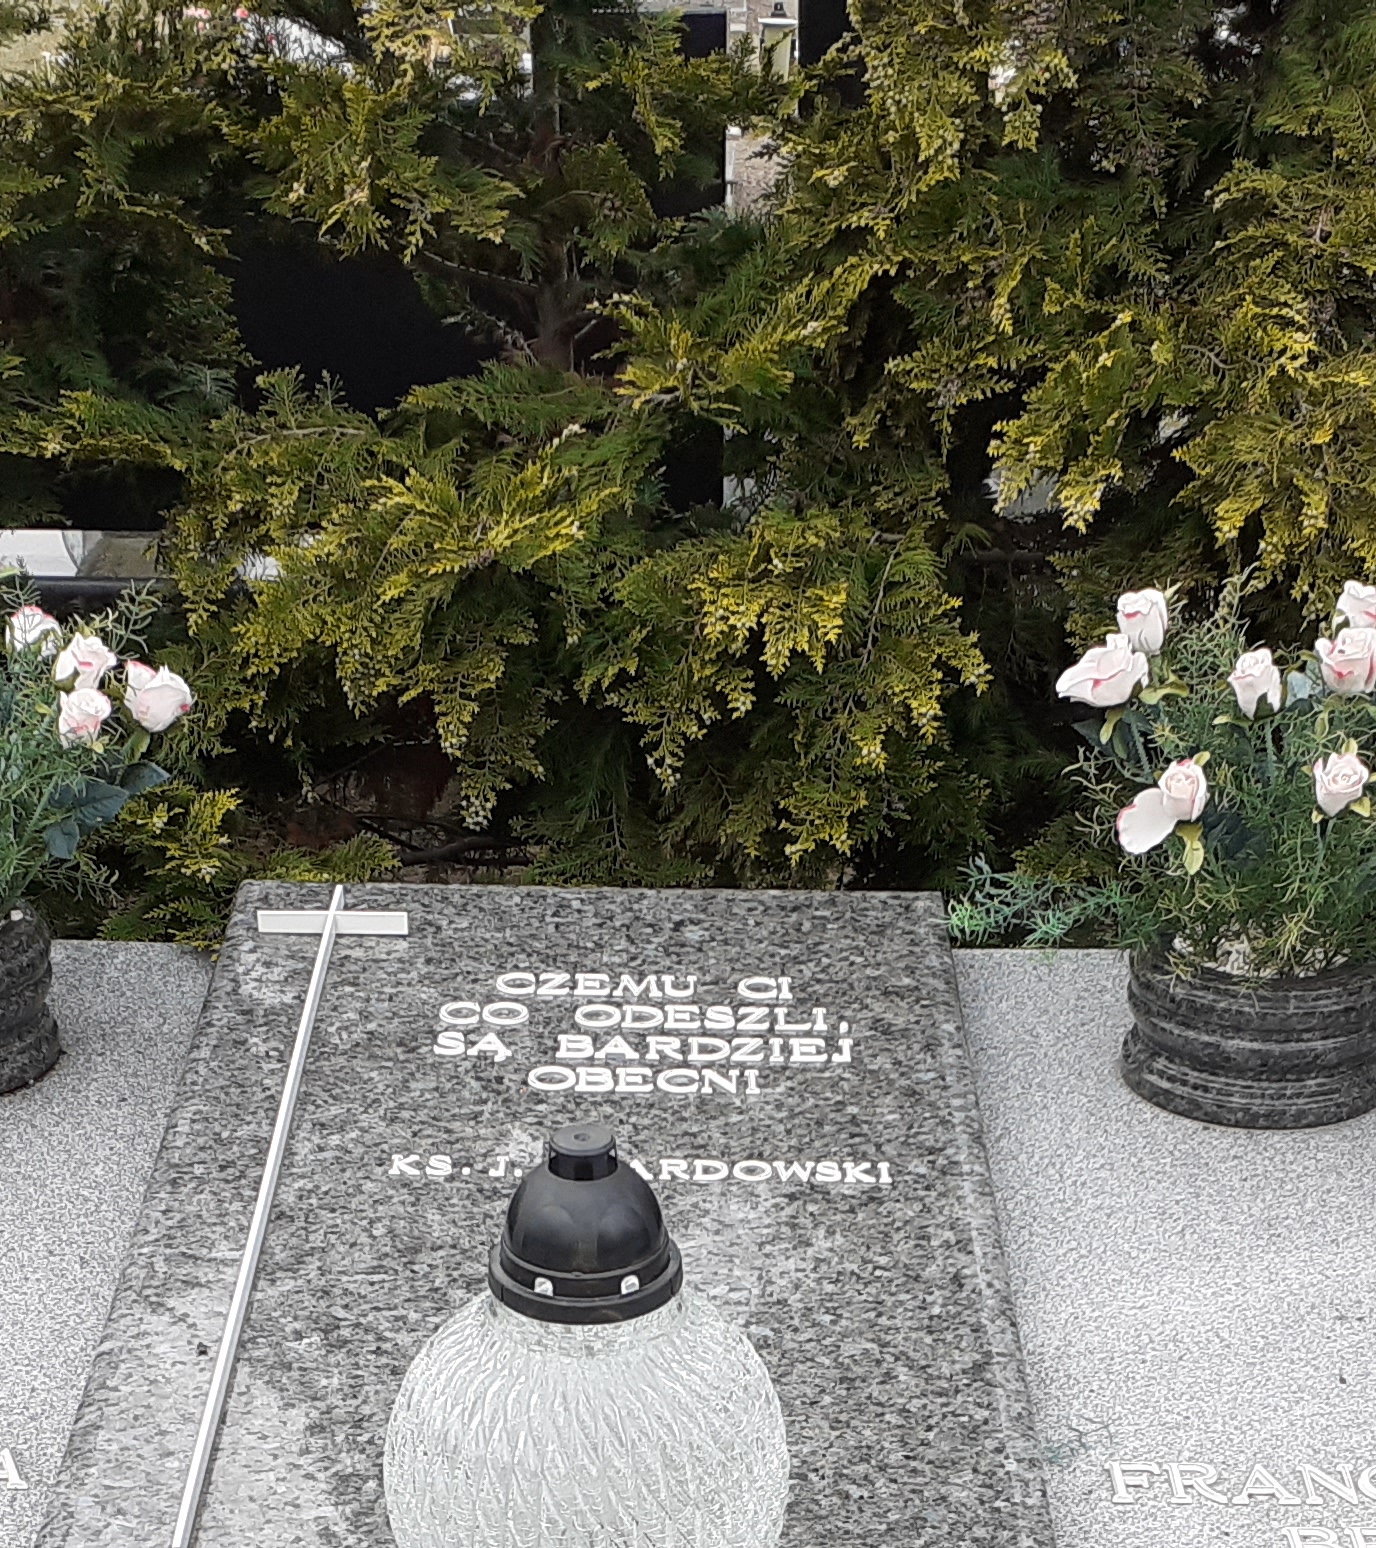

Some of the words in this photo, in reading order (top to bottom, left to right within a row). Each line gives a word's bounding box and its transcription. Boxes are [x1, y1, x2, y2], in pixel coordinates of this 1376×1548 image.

[496, 972, 697, 998] CZEMU
[737, 976, 793, 1000] CI
[439, 1001, 529, 1026] CO
[574, 1004, 849, 1033] ODESZLI,
[433, 1031, 512, 1062] SĄ
[556, 1034, 853, 1063] BARDZIEJ
[527, 1065, 761, 1095] OBECNI
[388, 1154, 471, 1176] KS.
[629, 1158, 893, 1184] RDOWSKI
